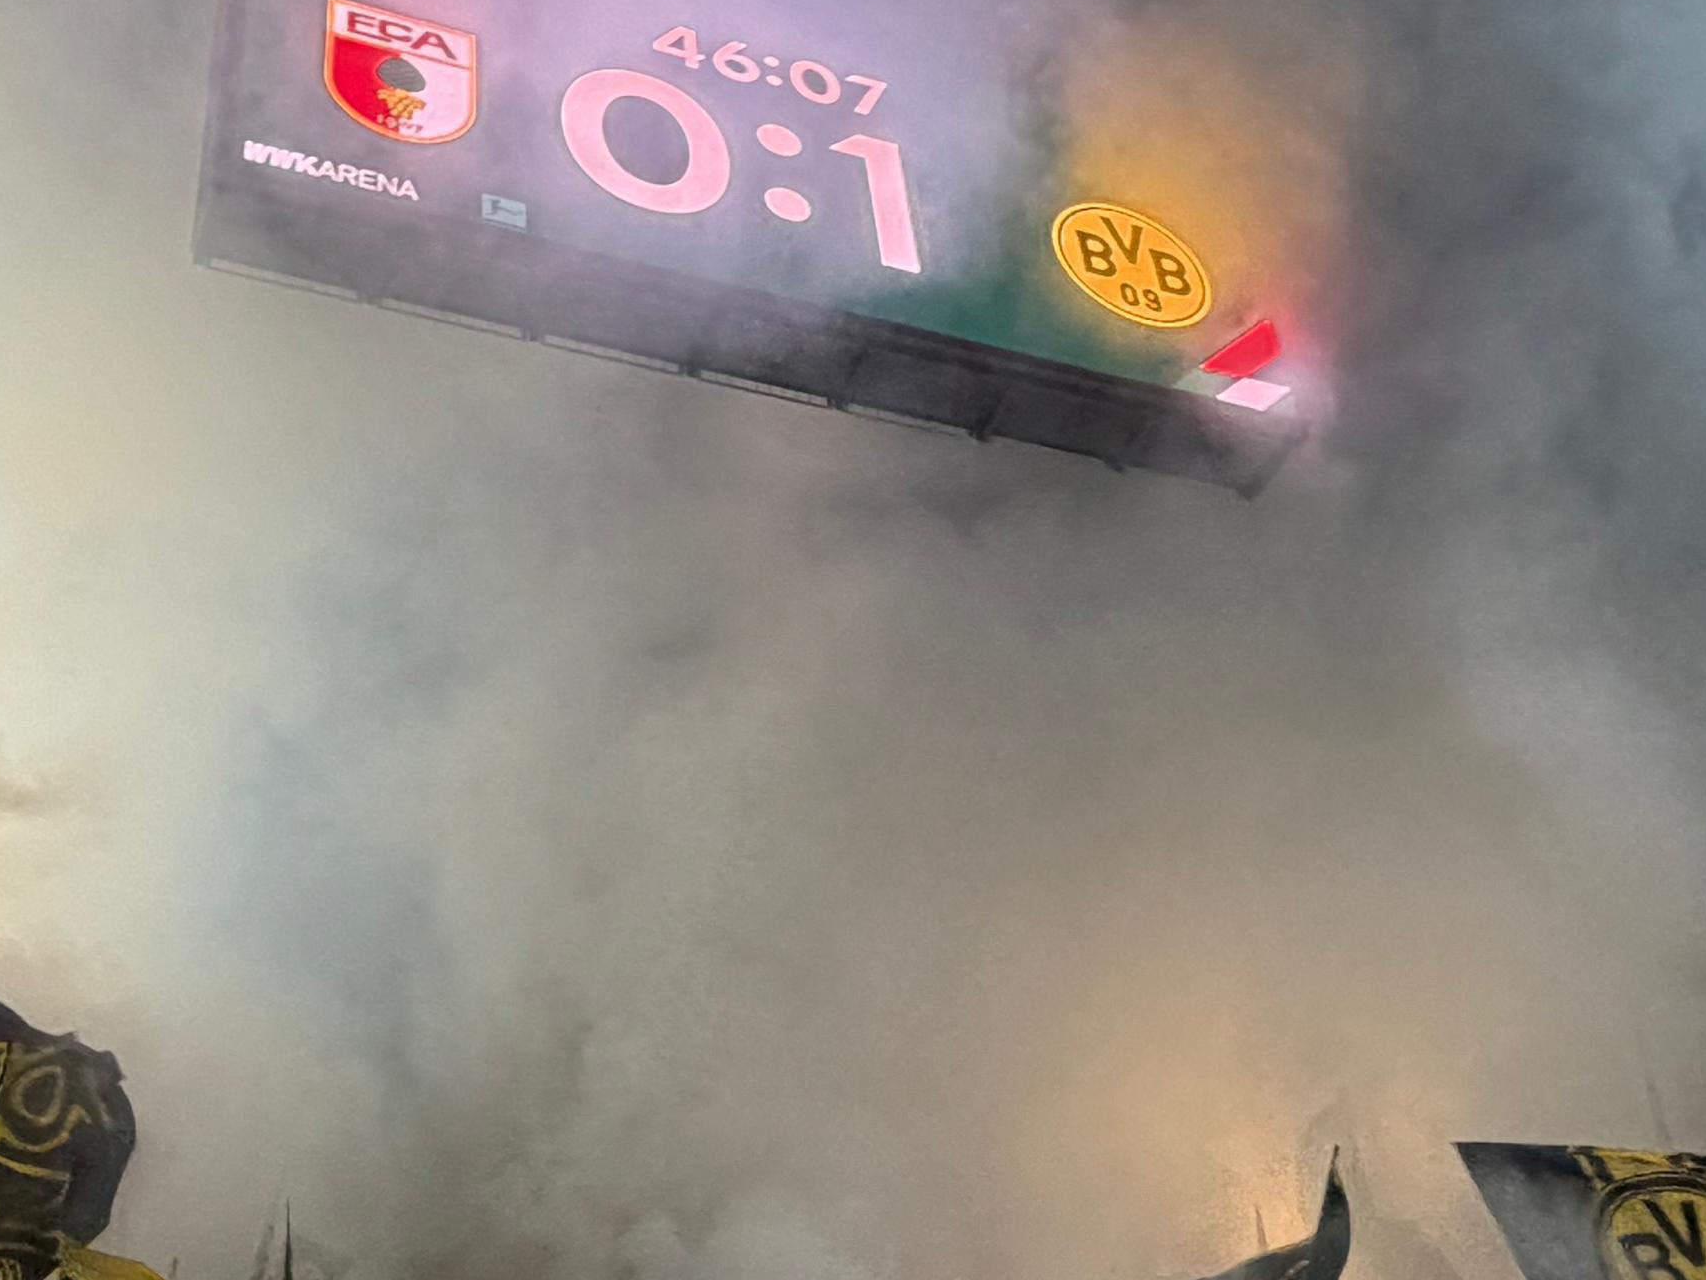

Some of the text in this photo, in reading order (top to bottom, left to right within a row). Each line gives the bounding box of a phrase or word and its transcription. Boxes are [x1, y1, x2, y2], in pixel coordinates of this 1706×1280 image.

[650, 26, 888, 116] 46:07
[560, 67, 922, 275] 0:1
[1073, 214, 1192, 298] BVB
[1119, 284, 1163, 315] 09
